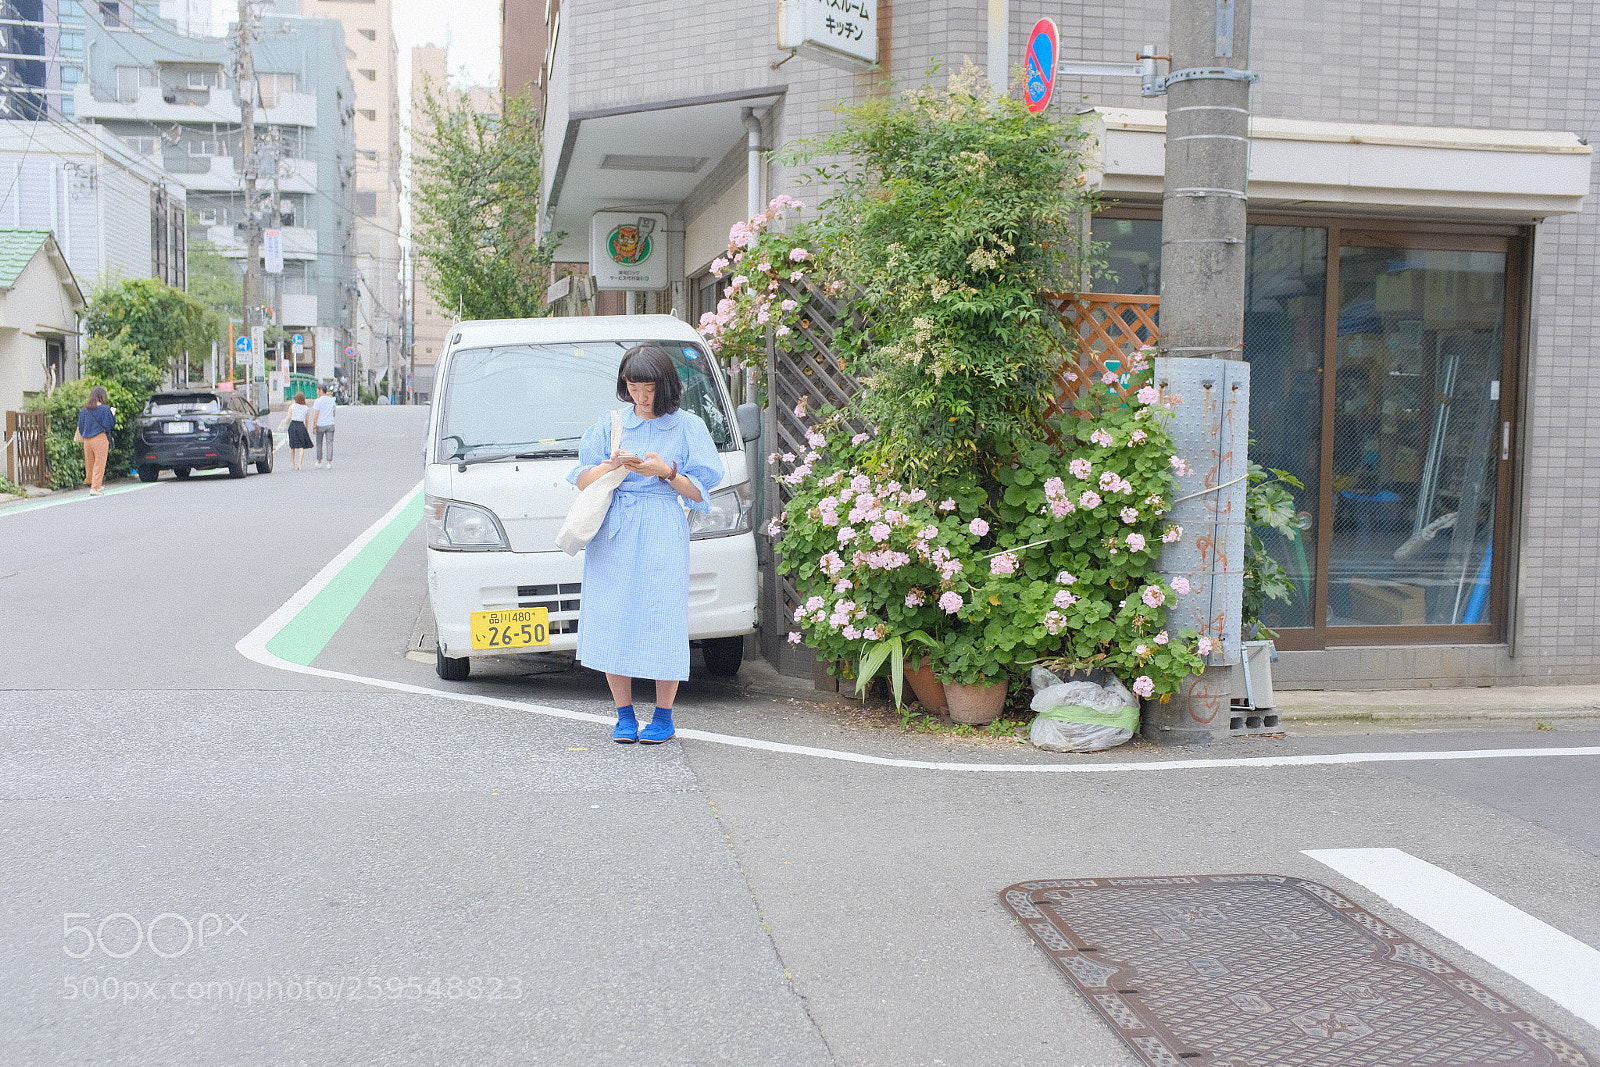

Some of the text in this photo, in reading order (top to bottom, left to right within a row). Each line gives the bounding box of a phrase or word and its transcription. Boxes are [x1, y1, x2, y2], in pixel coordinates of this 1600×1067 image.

[826, 15, 863, 41] キッチン
[475, 623, 545, 646] い 26-50
